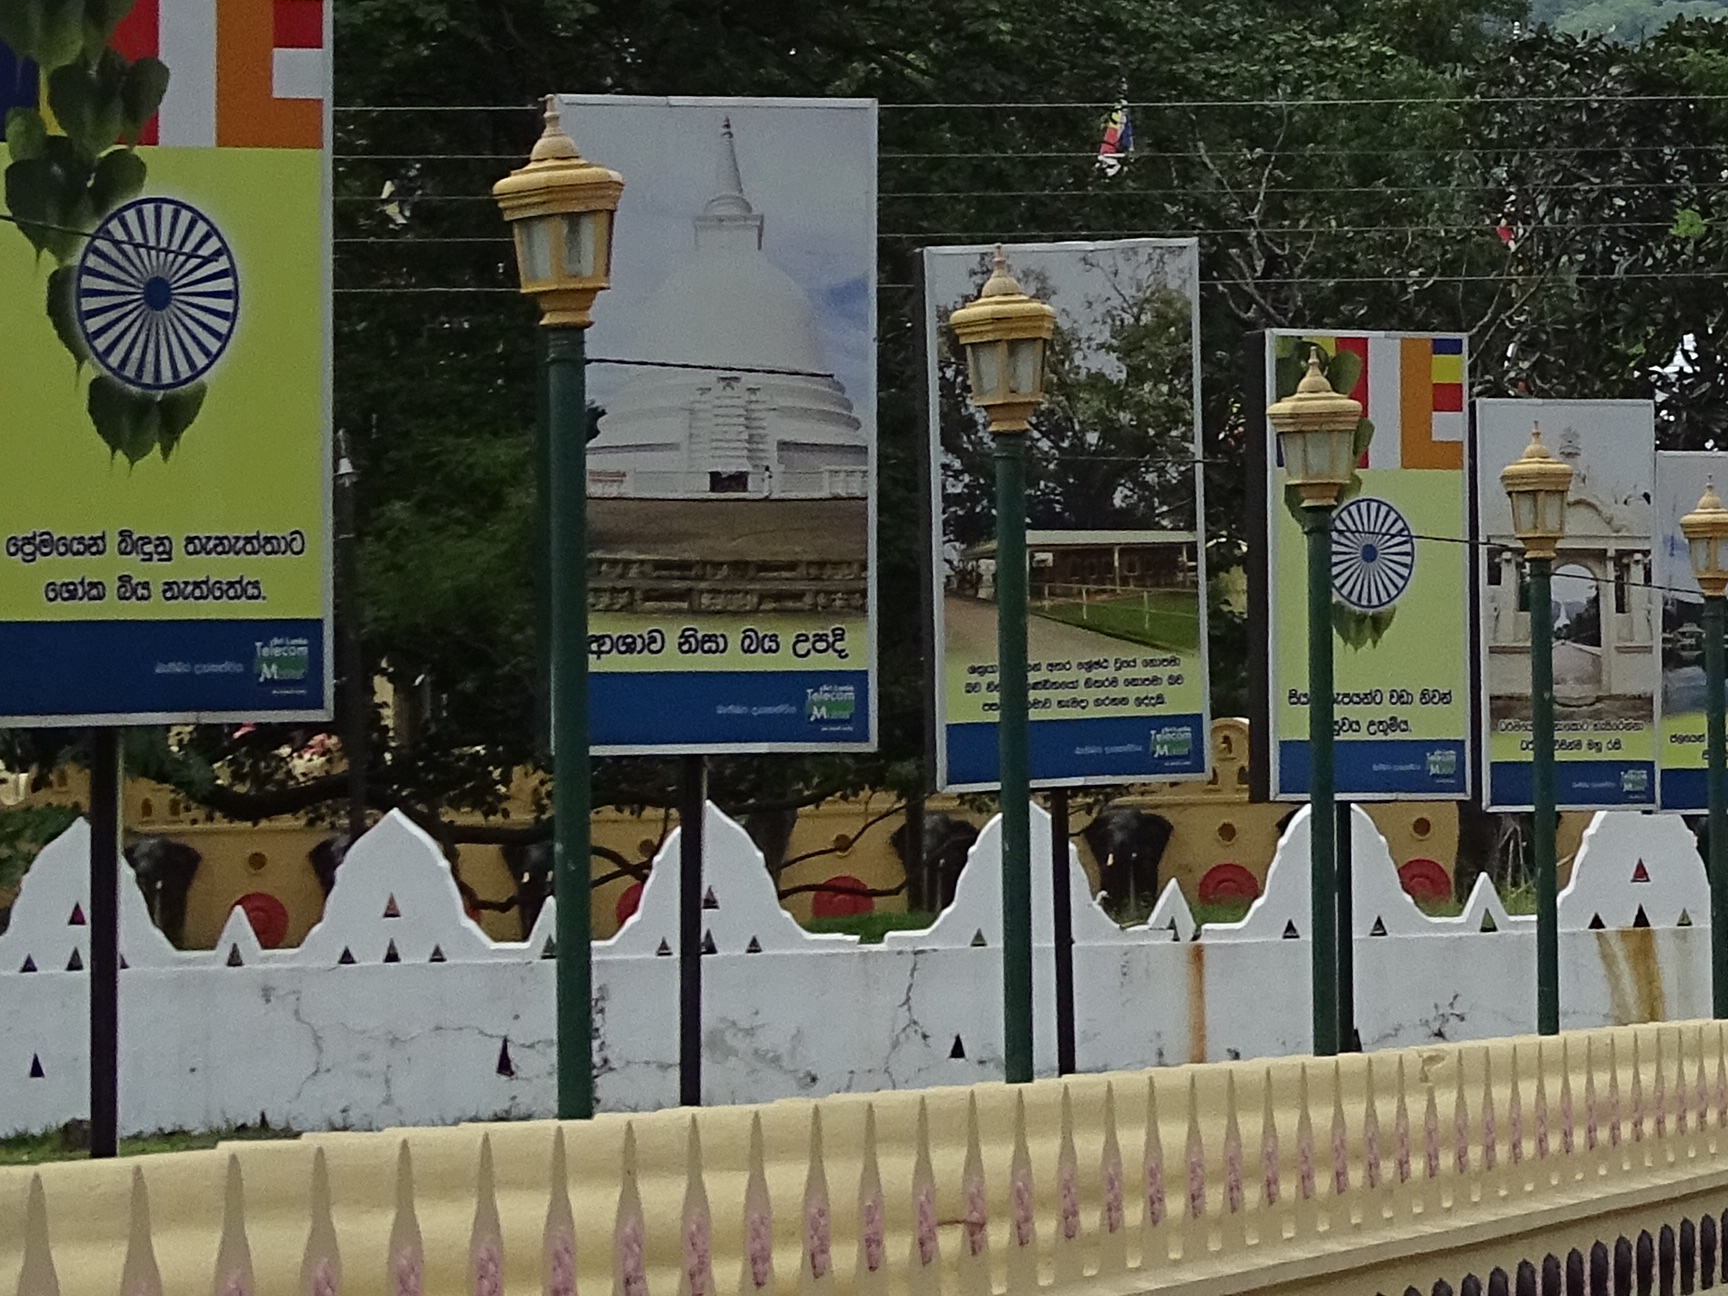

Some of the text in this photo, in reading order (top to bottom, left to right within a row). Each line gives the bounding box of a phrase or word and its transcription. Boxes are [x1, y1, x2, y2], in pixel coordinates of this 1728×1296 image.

[6, 531, 106, 563] ප්‍රේමයෙන්
[184, 530, 305, 557] තැනැත්තාට
[45, 576, 106, 602] ශෝක
[117, 574, 152, 602] බිය
[255, 641, 308, 657] Telecom
[678, 627, 728, 655] නිසා
[806, 689, 855, 702] Telecom
